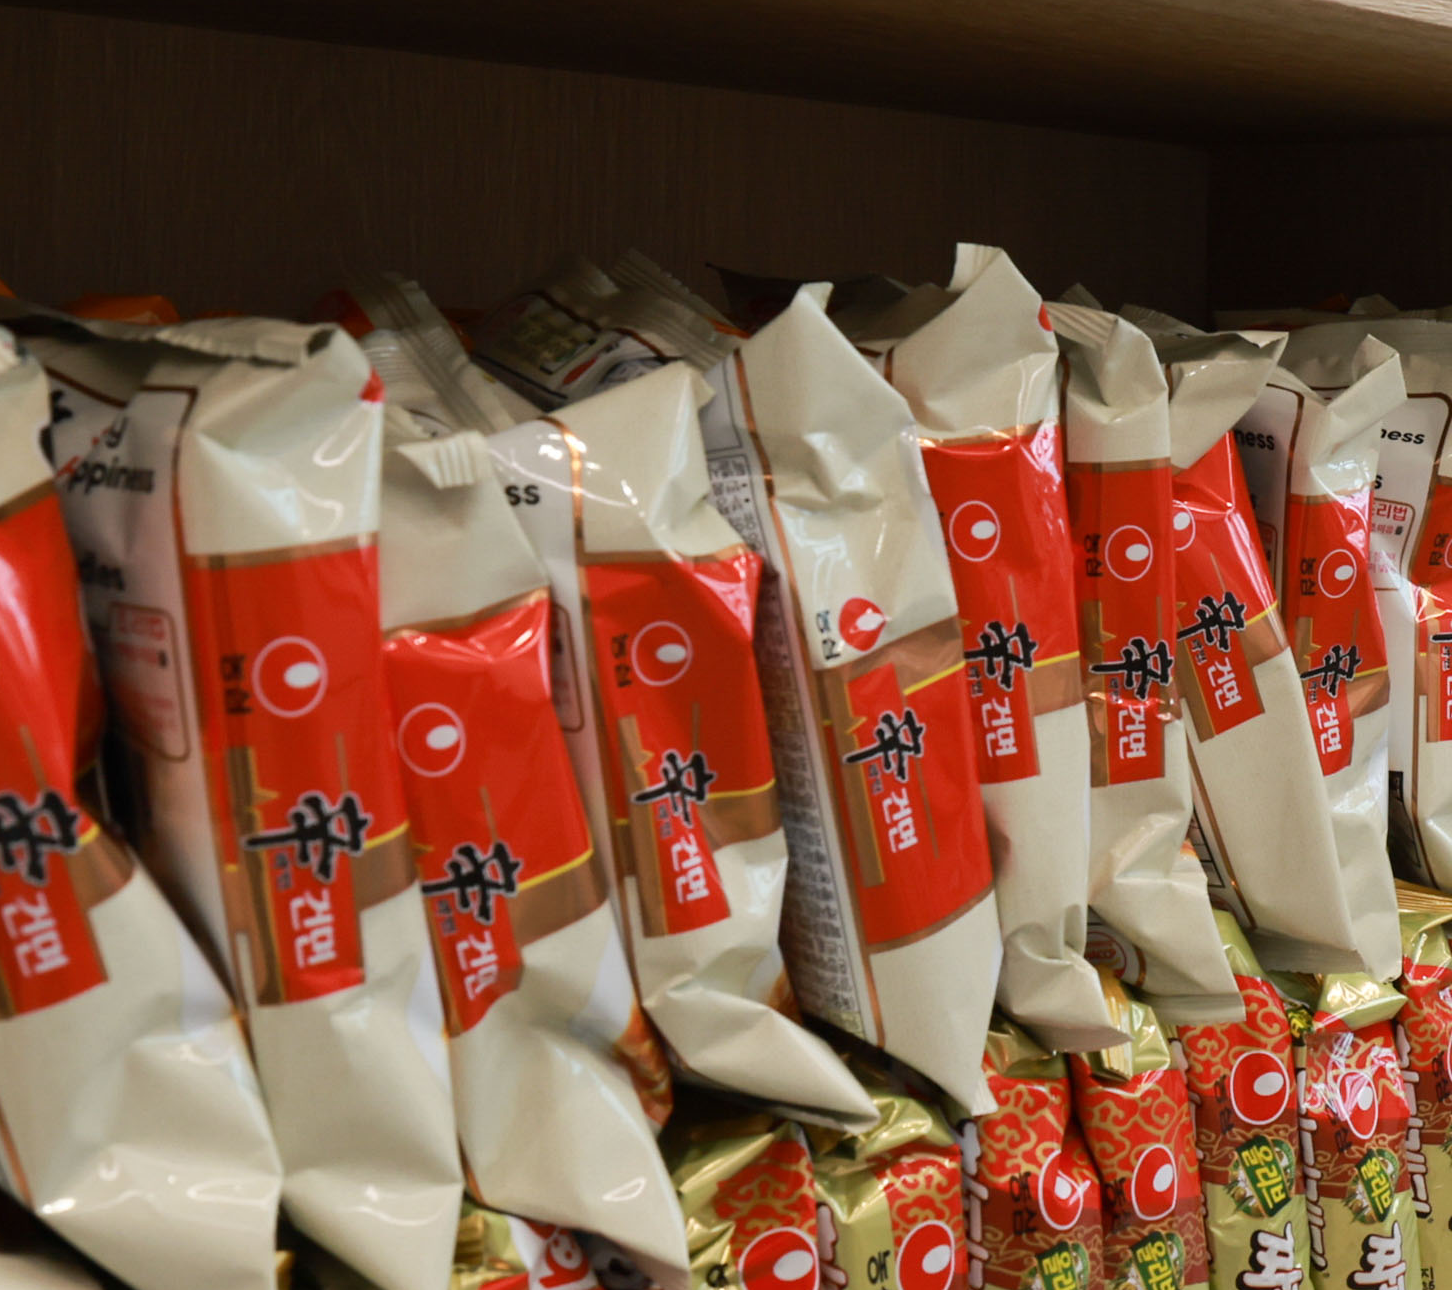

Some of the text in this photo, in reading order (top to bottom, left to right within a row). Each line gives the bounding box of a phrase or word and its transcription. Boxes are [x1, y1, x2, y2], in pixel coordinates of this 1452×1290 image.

[962, 619, 1040, 691] 辛
[1176, 590, 1248, 652] 辛
[1088, 637, 1174, 700] 辛
[1206, 656, 1243, 710] 건면
[1300, 643, 1364, 700] 辛
[845, 708, 928, 782] 辛
[980, 695, 1019, 759] 건면
[1117, 705, 1148, 760] 건면
[1314, 694, 1343, 754] 건면
[632, 748, 717, 827] 辛
[881, 786, 920, 854] 건면
[242, 790, 374, 883] 辛
[668, 824, 712, 905] 건면
[421, 841, 526, 927] 辛
[1, 891, 68, 978] 건면
[289, 889, 337, 969] 건면
[455, 930, 499, 1002] 건면
[1241, 1145, 1286, 1208] 올리브
[1357, 1157, 1395, 1213] 올리브
